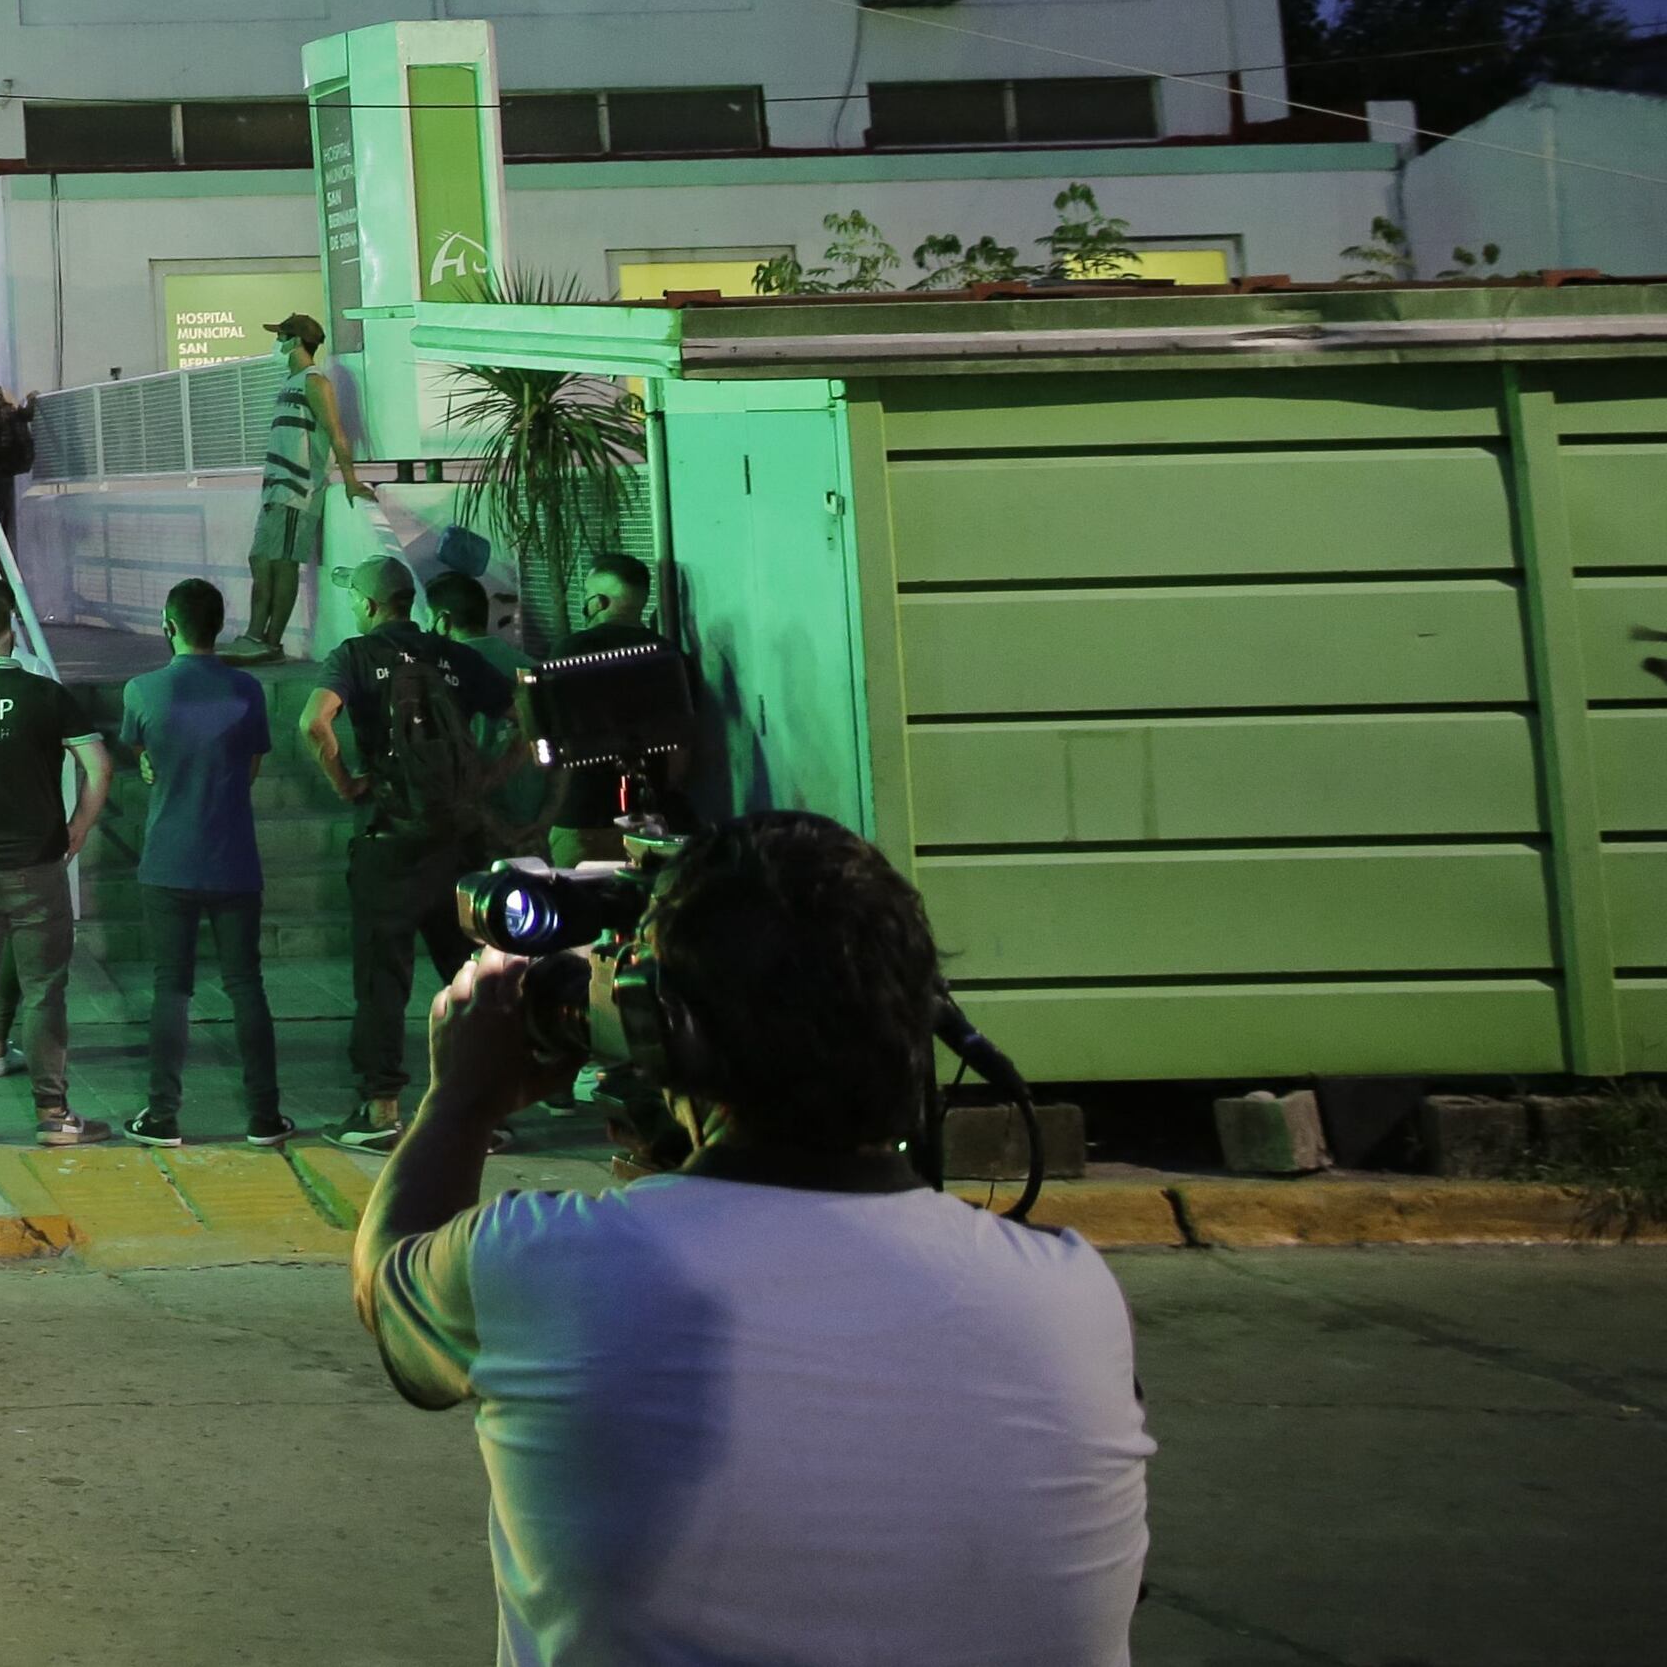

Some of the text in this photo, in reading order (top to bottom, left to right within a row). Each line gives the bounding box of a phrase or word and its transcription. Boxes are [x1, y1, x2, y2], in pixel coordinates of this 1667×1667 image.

[176, 311, 235, 325] HOSPITAL
[177, 326, 246, 340] MUNICIPAL
[178, 342, 208, 354] SAN
